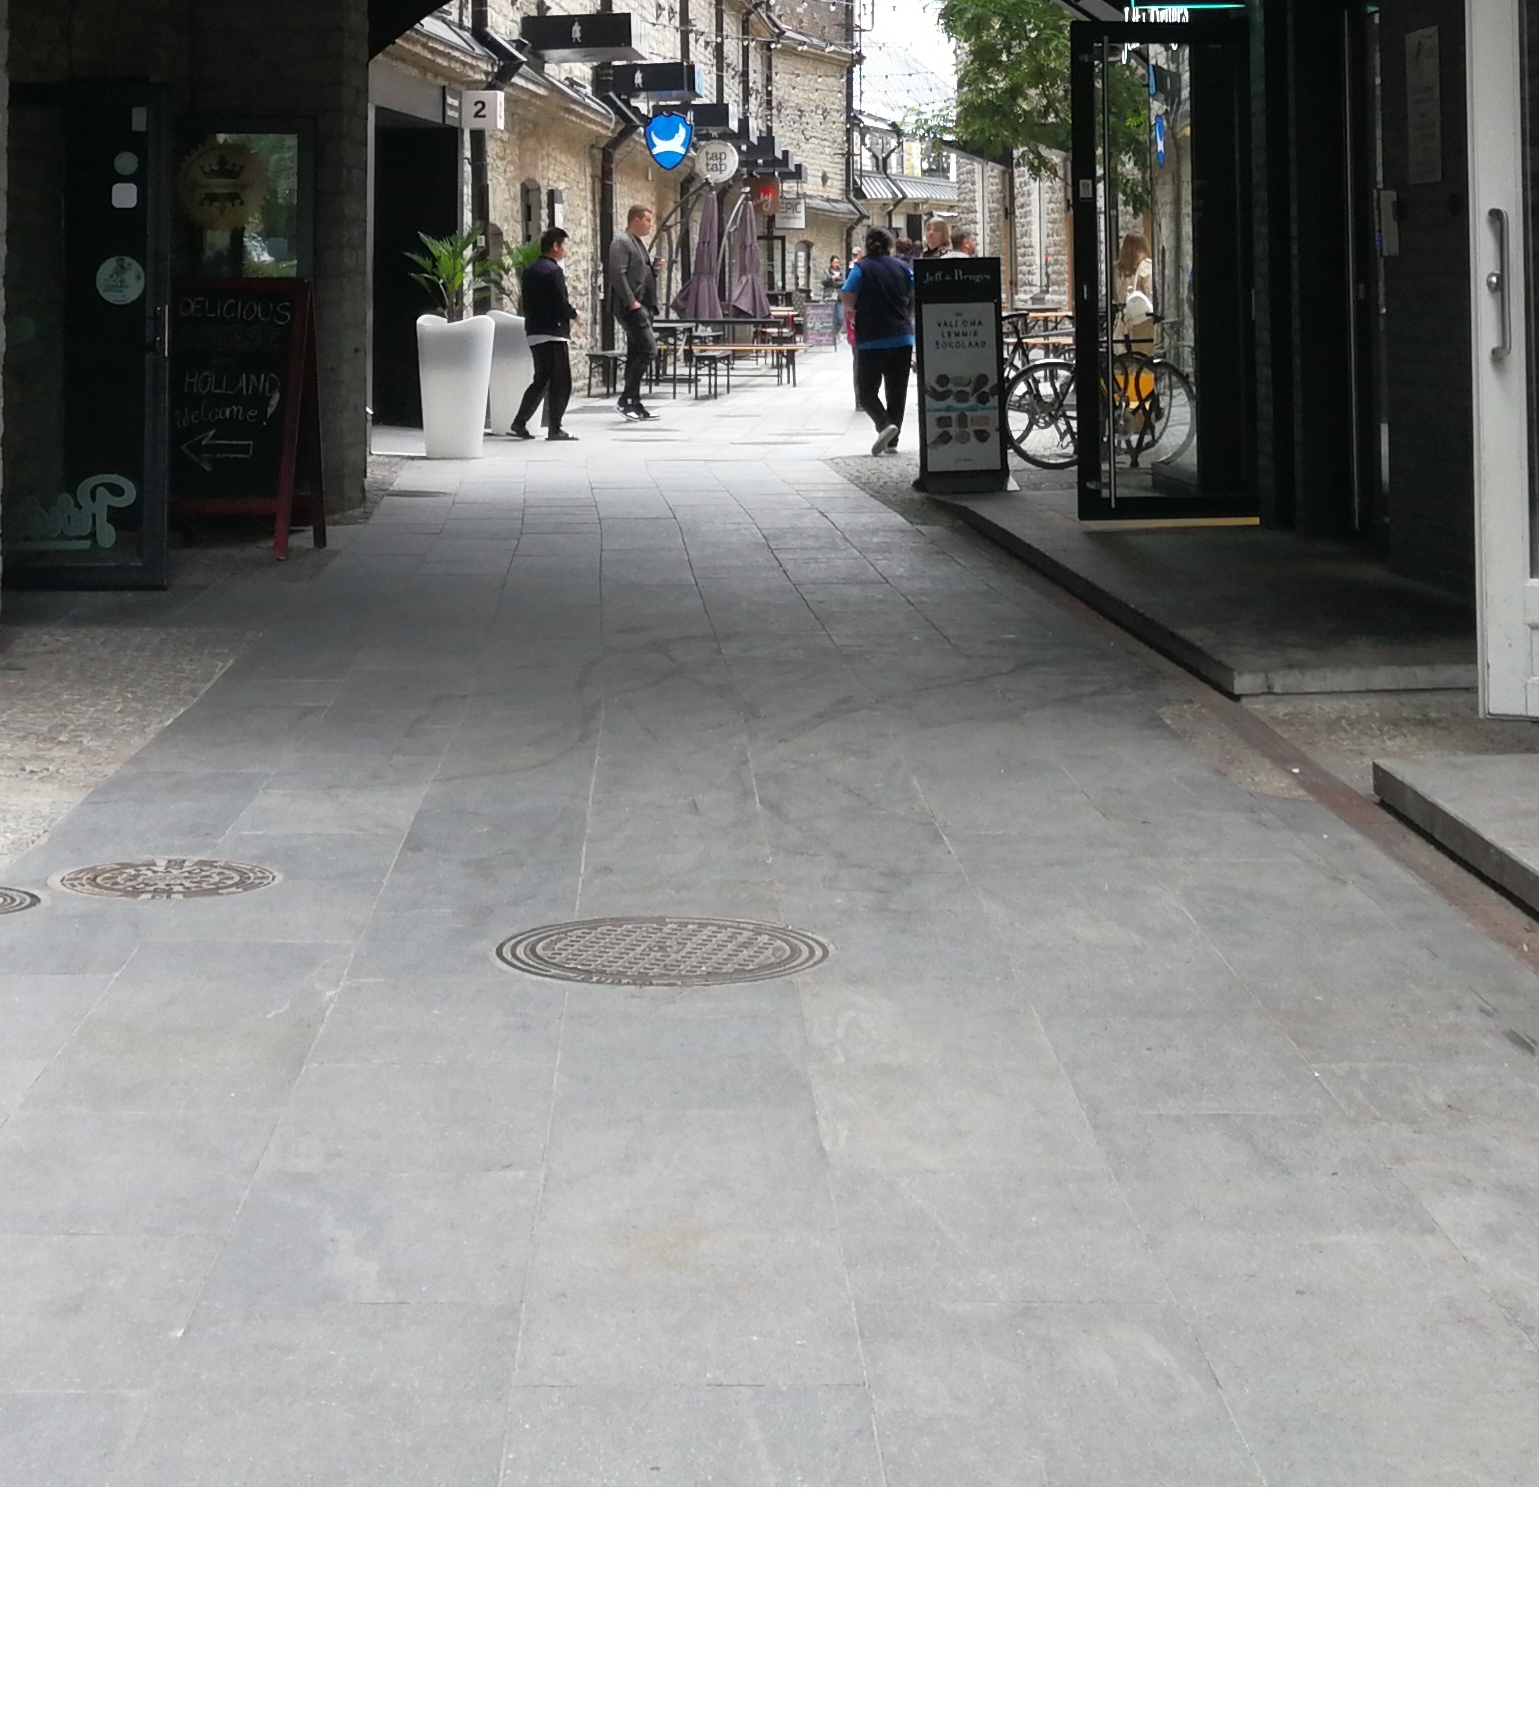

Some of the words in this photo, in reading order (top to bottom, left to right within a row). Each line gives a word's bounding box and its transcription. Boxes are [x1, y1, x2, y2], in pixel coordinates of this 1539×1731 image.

[473, 100, 487, 119] 2
[705, 151, 727, 164] tap
[705, 161, 728, 175] tap
[923, 270, 943, 284] Jeff
[954, 268, 991, 283] Bruges
[179, 297, 292, 326] DELICIOUS
[184, 370, 281, 397] HOLLAND
